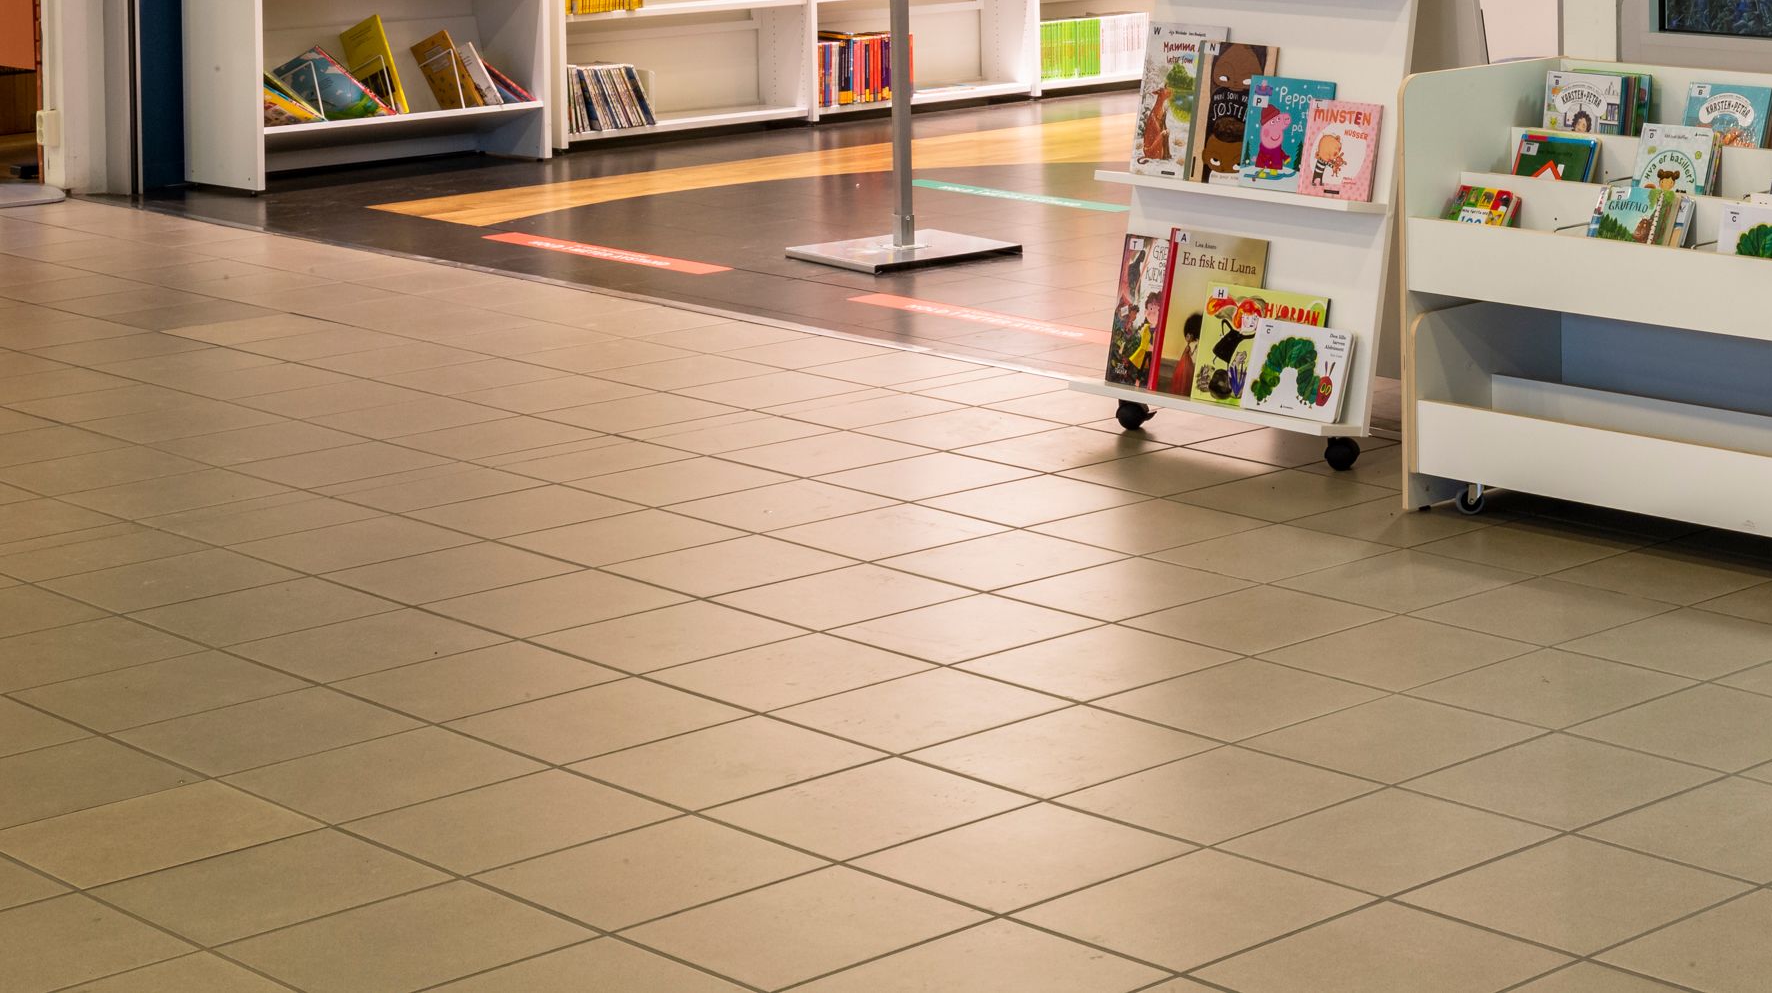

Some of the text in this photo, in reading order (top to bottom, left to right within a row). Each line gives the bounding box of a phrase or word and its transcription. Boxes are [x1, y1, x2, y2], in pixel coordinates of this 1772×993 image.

[1163, 41, 1196, 53] Mamma
[1212, 102, 1249, 121] SØSTE
[1313, 108, 1372, 126] MINSTEN
[1291, 121, 1303, 135] på
[1644, 164, 1657, 180] Hva
[1670, 152, 1695, 185] basiller?
[1608, 199, 1649, 214] GRUFFALO
[1180, 233, 1187, 242] A
[1181, 251, 1257, 275] En fisk til Luna
[1217, 289, 1224, 297] H
[1264, 302, 1320, 327] HVORDAN
